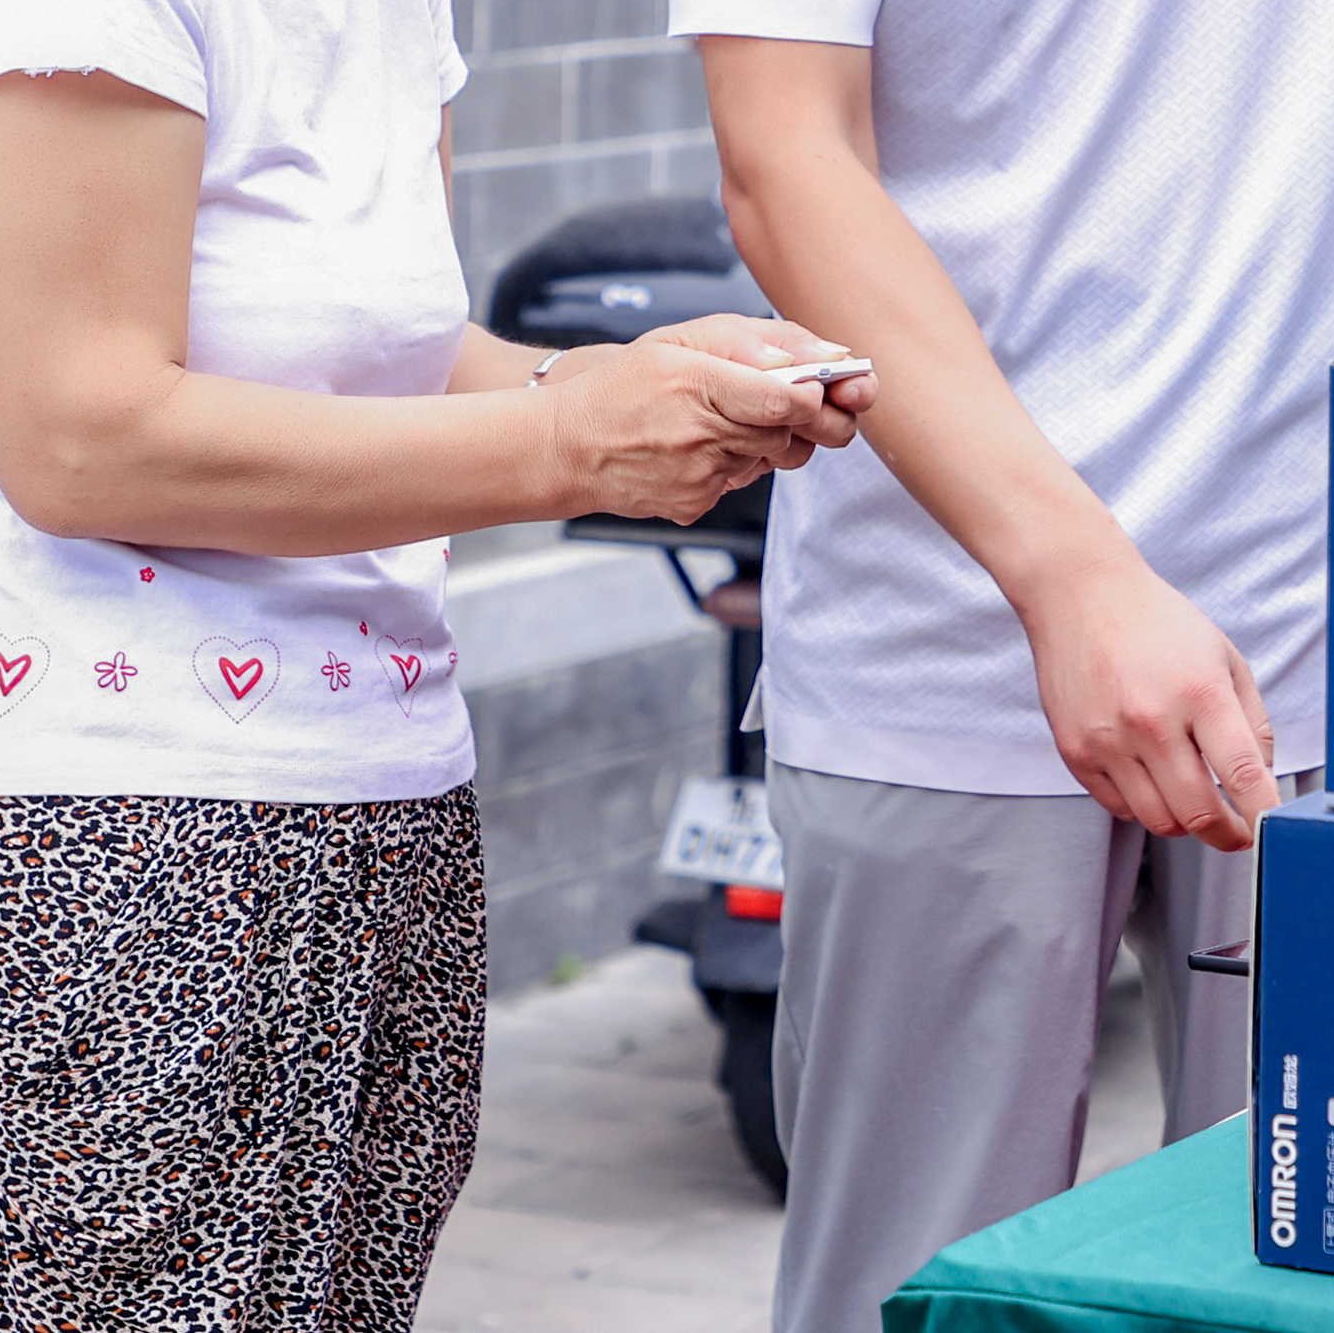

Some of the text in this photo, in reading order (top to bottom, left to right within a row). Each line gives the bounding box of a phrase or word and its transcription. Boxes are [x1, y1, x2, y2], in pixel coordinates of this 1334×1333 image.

[1270, 1053, 1298, 1248] OMRON 欧姆龙
